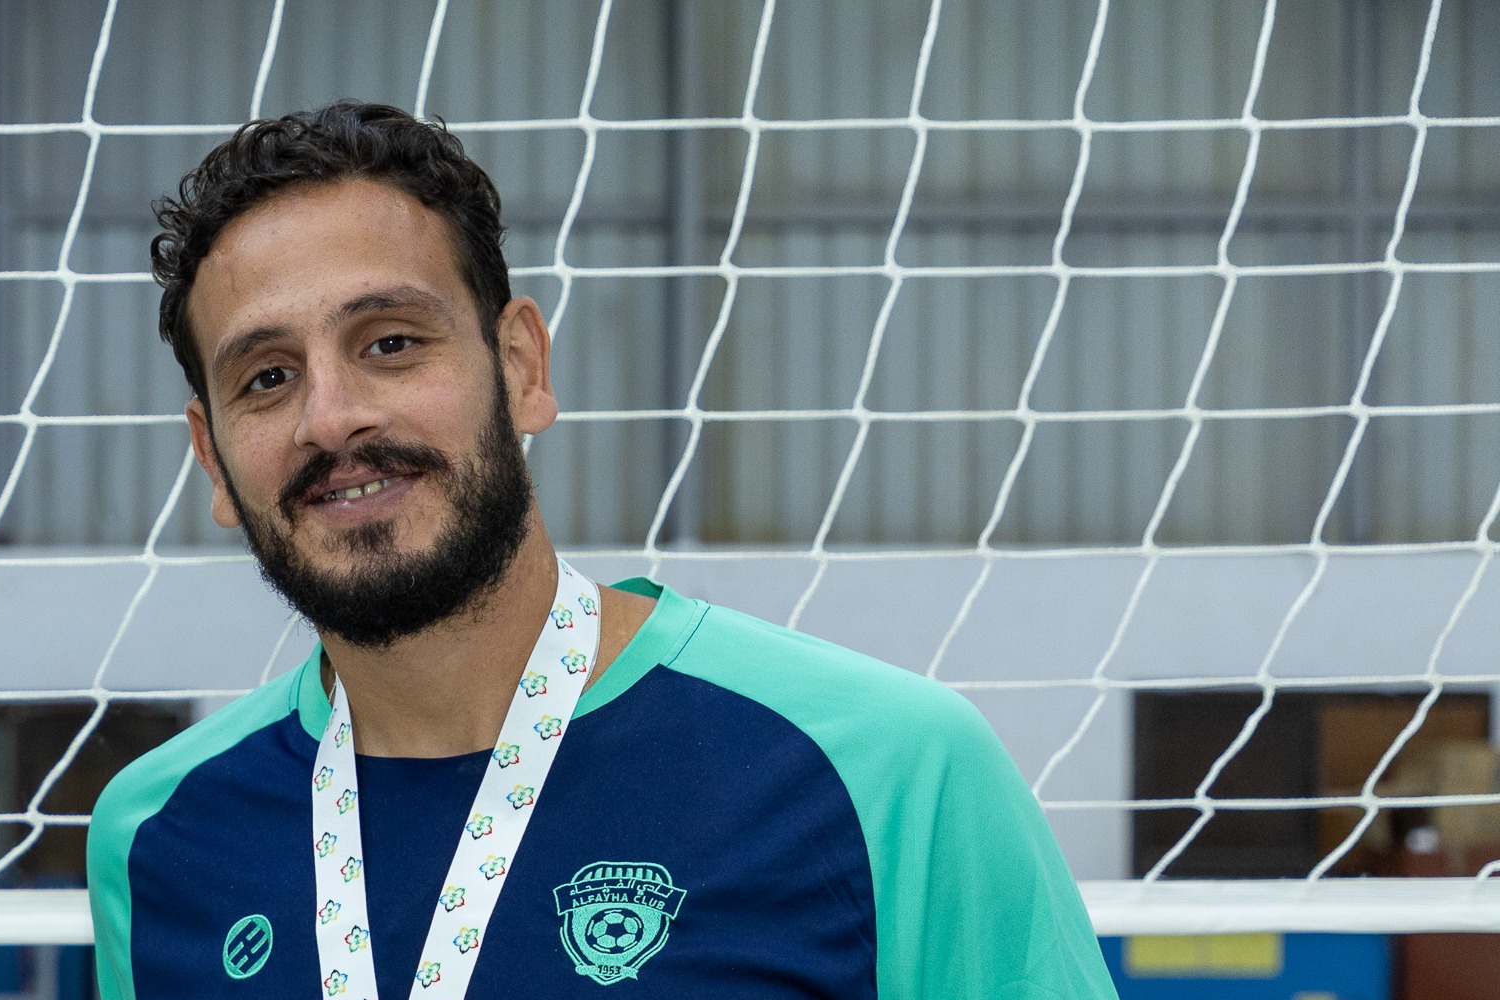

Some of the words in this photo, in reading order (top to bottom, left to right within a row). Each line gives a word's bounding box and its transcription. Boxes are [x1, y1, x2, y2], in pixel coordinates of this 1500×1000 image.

[572, 893, 628, 909] ALFAYHA
[633, 895, 666, 910] CLUB
[598, 964, 622, 975] 1953
